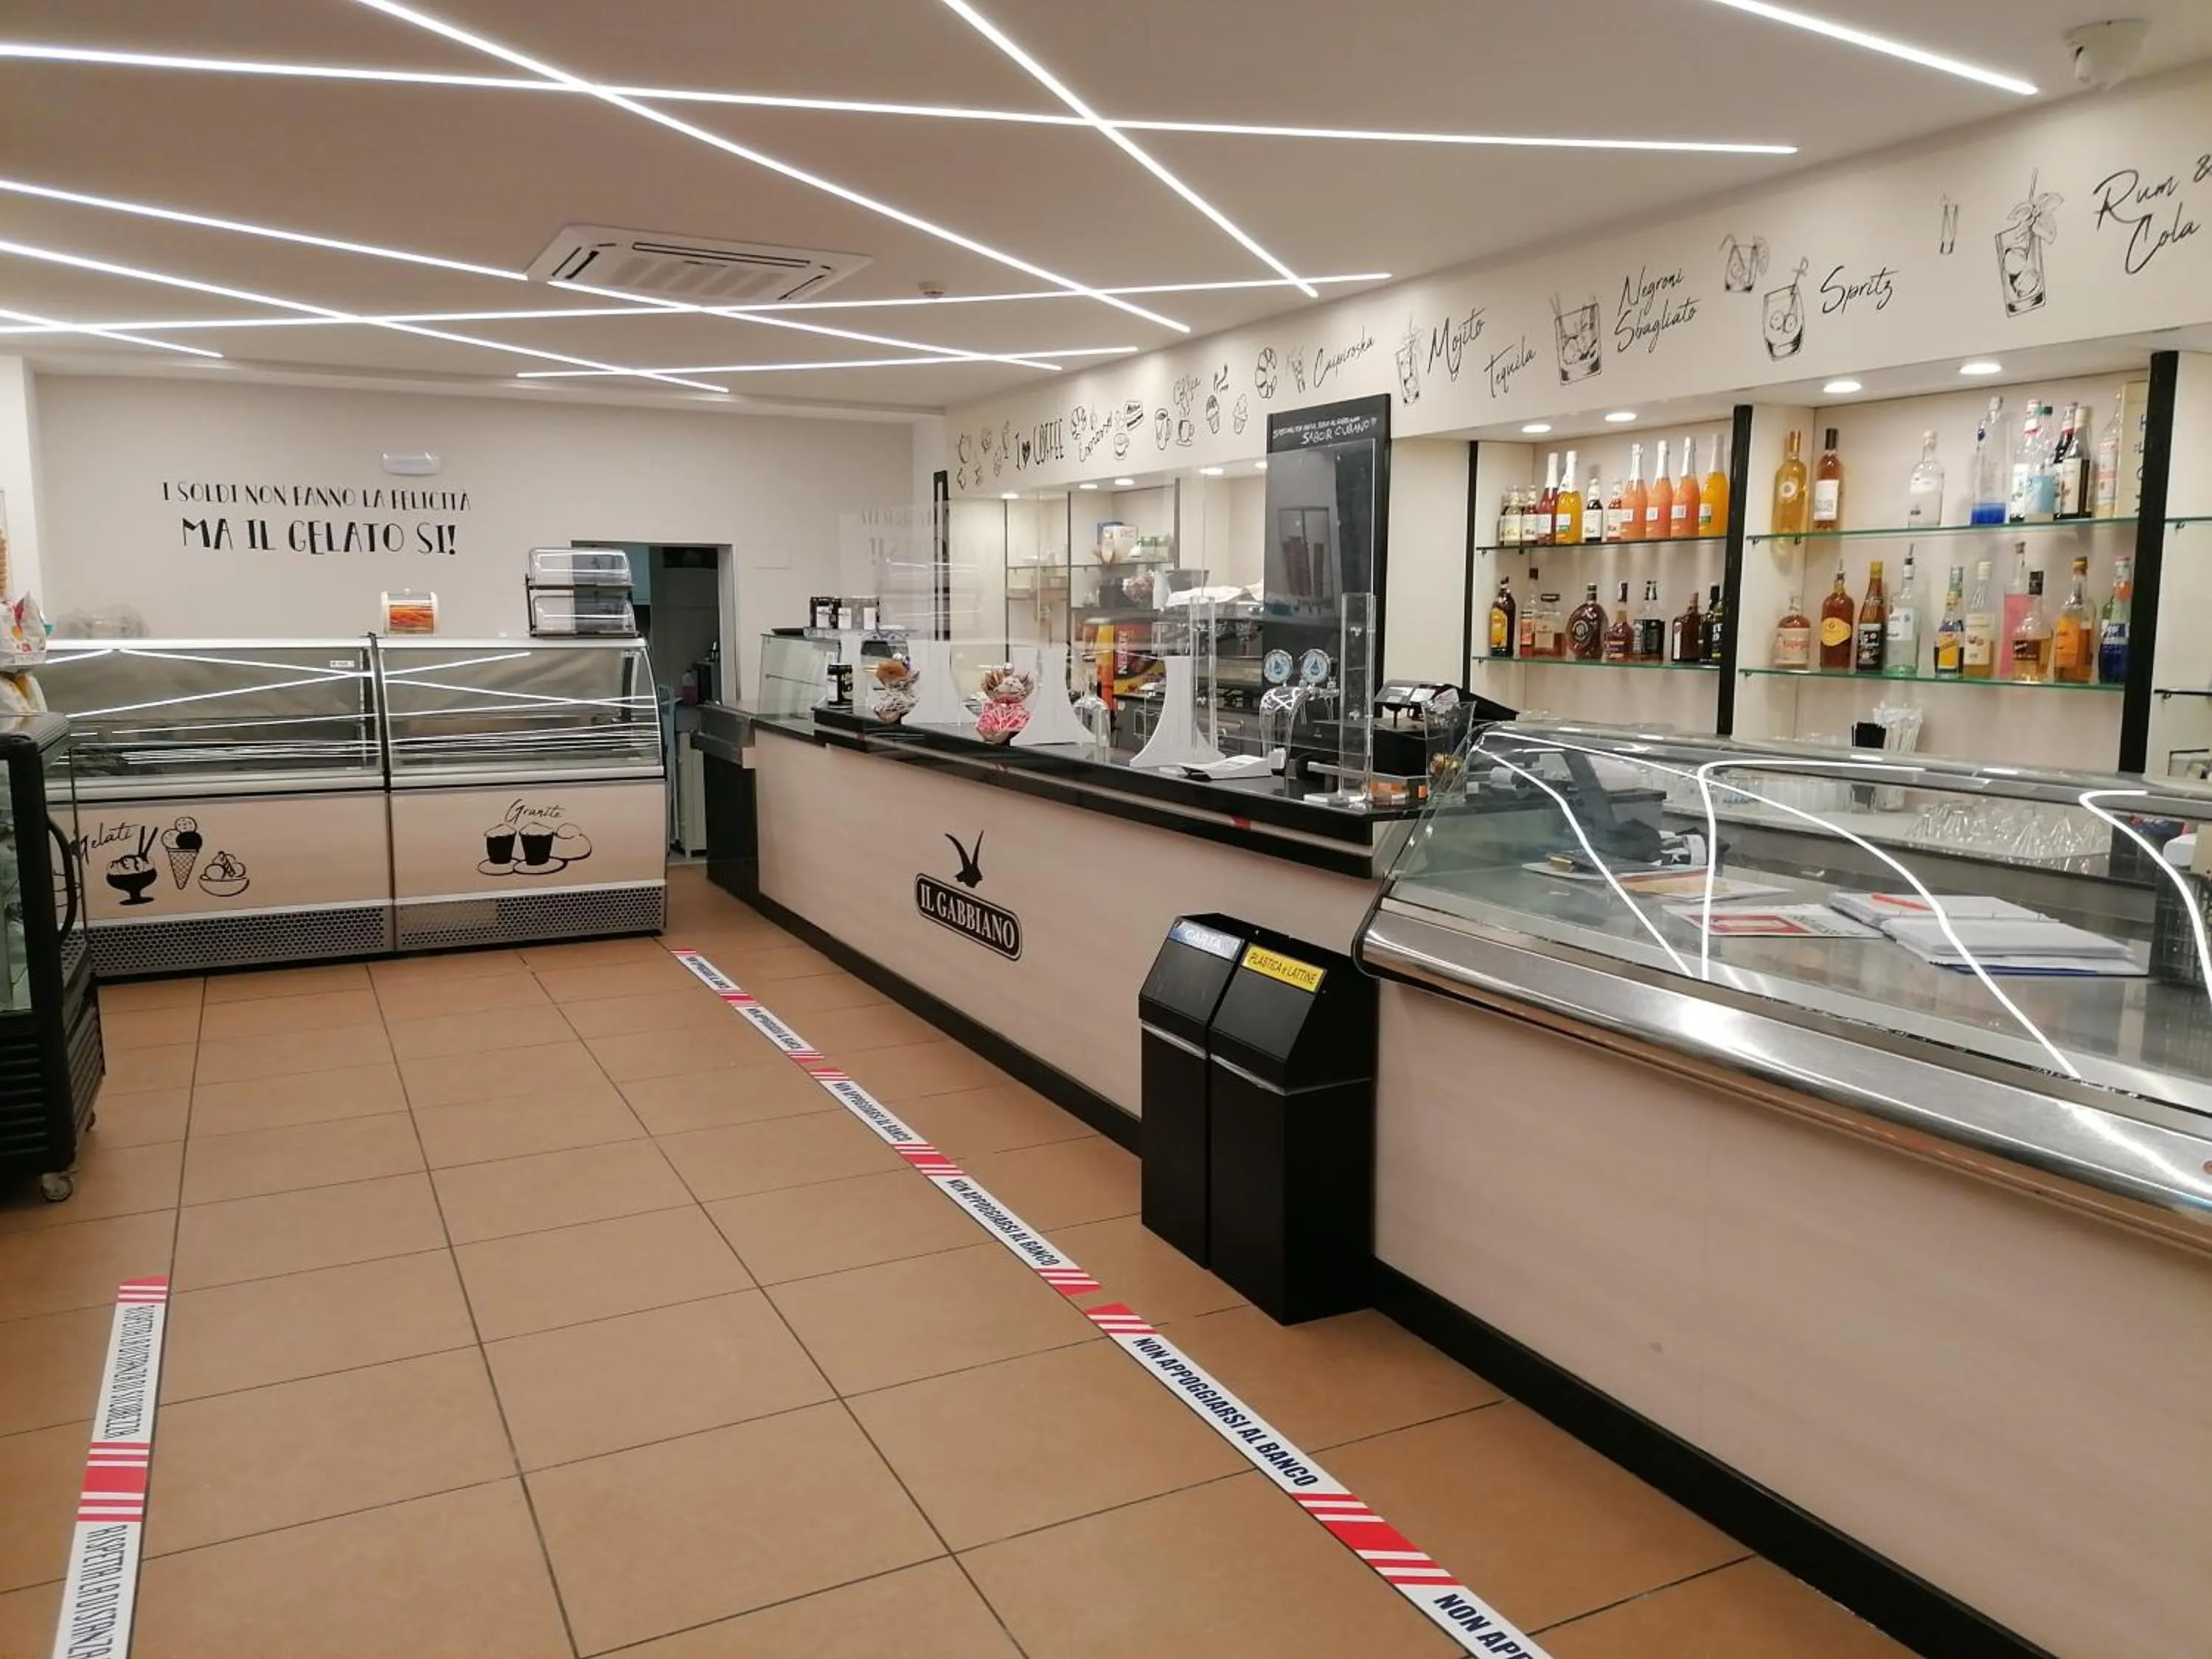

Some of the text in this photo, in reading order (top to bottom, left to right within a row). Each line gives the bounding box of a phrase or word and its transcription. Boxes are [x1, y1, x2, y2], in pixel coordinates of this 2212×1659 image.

[2093, 169, 2180, 231] Rum
[2124, 201, 2202, 274] Cola
[1618, 267, 1684, 313] Negroni
[1819, 266, 1899, 316] Spritz
[1427, 307, 1487, 382] Mojito
[1614, 296, 1700, 353] Sbagliato
[1484, 335, 1537, 398] Tequila
[162, 481, 170, 501] I
[178, 483, 237, 504] SOLDI
[246, 484, 288, 507] NON
[294, 486, 355, 509] FANNO
[363, 489, 386, 508] LA
[182, 518, 233, 550] MA
[247, 519, 276, 551] IL
[288, 519, 405, 555] GELATO
[921, 884, 1015, 948] IL GABBIANO
[1184, 929, 1222, 948] CARTA
[1248, 952, 1283, 972] PLASTICA
[1284, 966, 1318, 985] LATTINE
[1019, 1241, 1060, 1266] BANCO
[1133, 1338, 1319, 1487] NON APPOGGIARSI AL BANCO
[80, 1524, 128, 1581] RISPETTA
[77, 1576, 122, 1599] LA
[1433, 1593, 1492, 1632] NON
